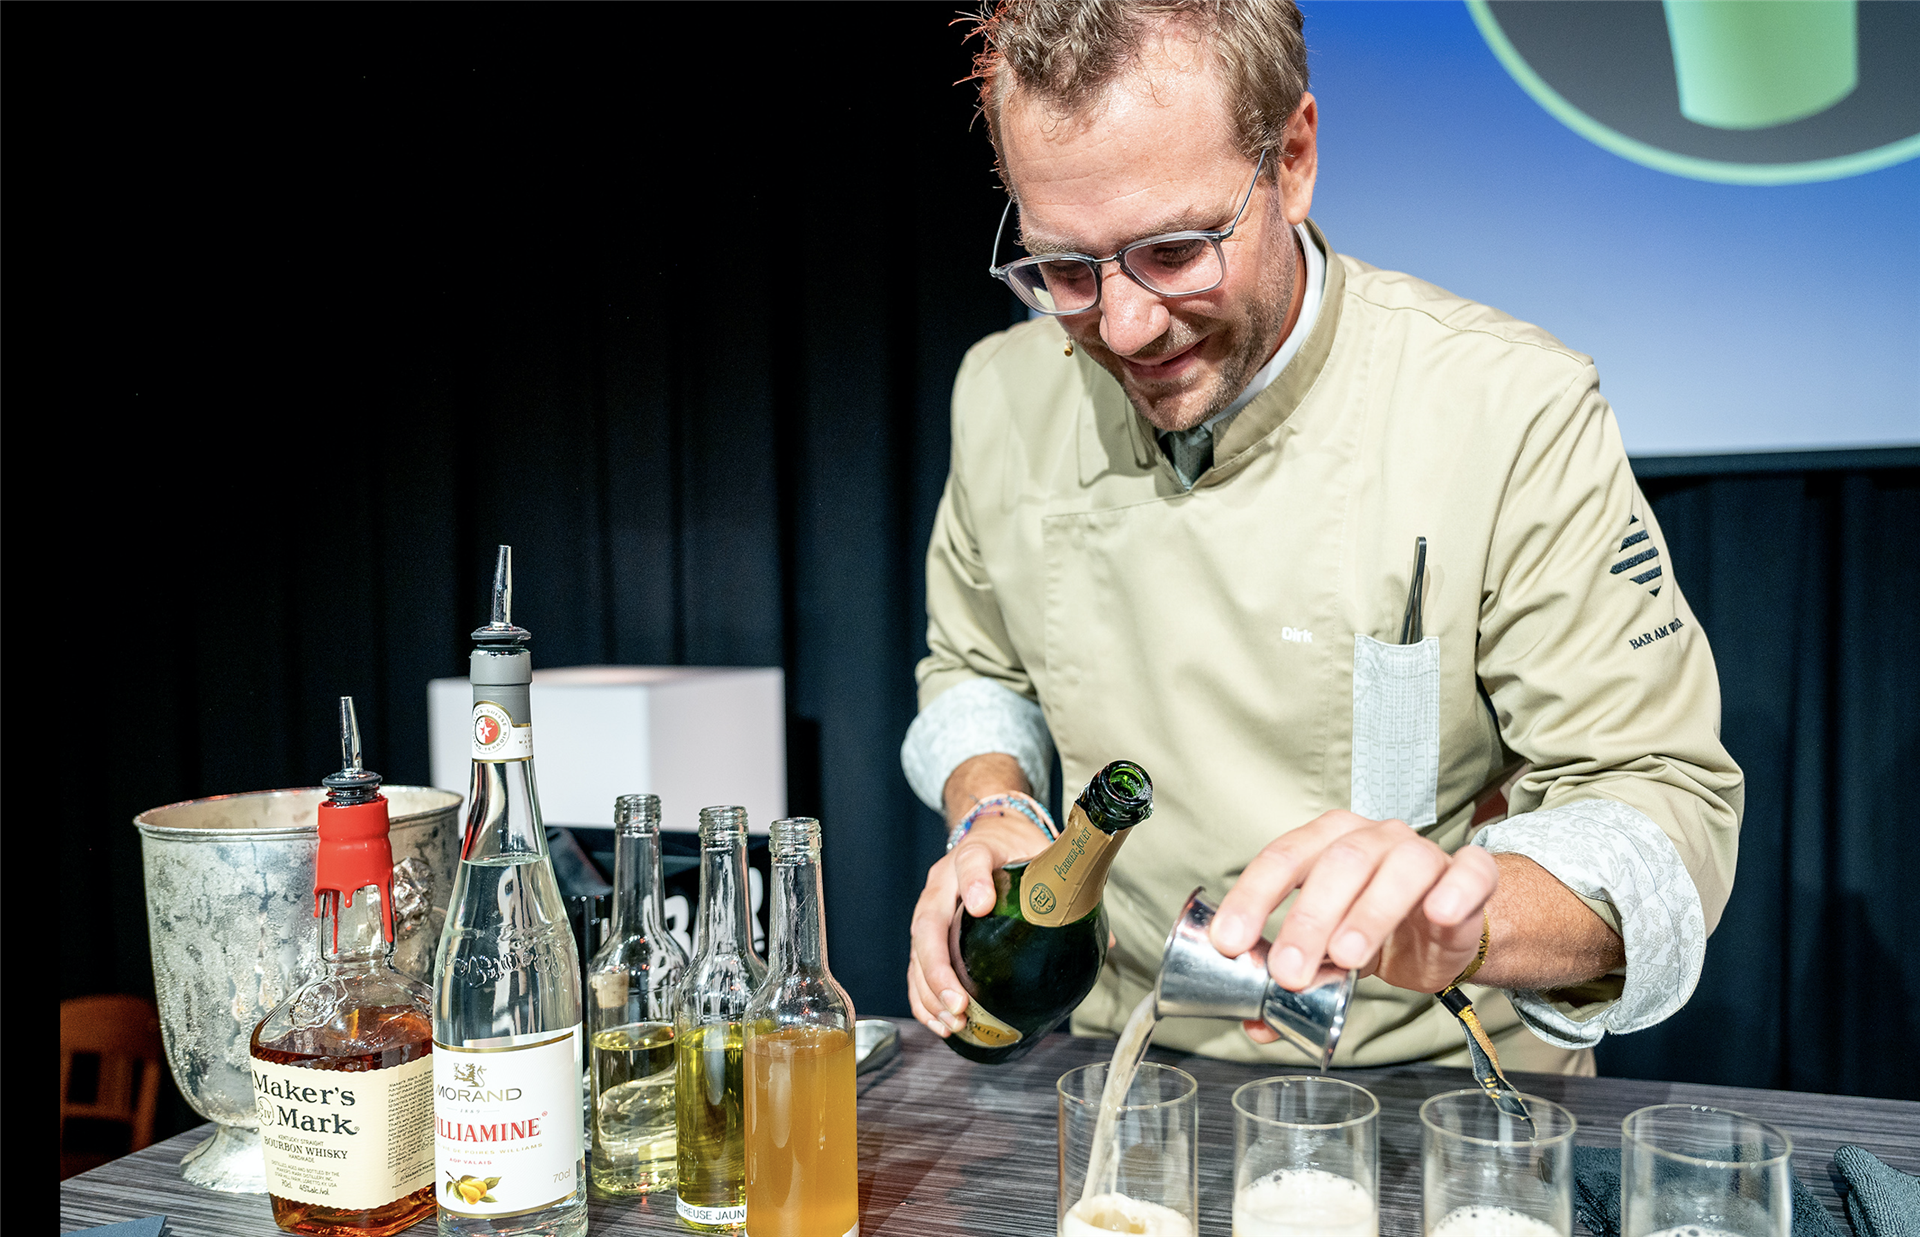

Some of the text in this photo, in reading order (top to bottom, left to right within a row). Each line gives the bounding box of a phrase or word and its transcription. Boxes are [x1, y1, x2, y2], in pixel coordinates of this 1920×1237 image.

[1281, 626, 1313, 643] Dirk
[1629, 633, 1655, 650] BAR
[1654, 625, 1670, 640] AM
[253, 1069, 356, 1106] Maker's
[436, 1084, 523, 1103] MORAND
[276, 1105, 357, 1135] Mark
[434, 1112, 541, 1143] ILLIAMINE
[264, 1136, 348, 1160] BOURBON WHISKY
[499, 1142, 543, 1155] WILLIAMS
[552, 1168, 571, 1184] 70cl
